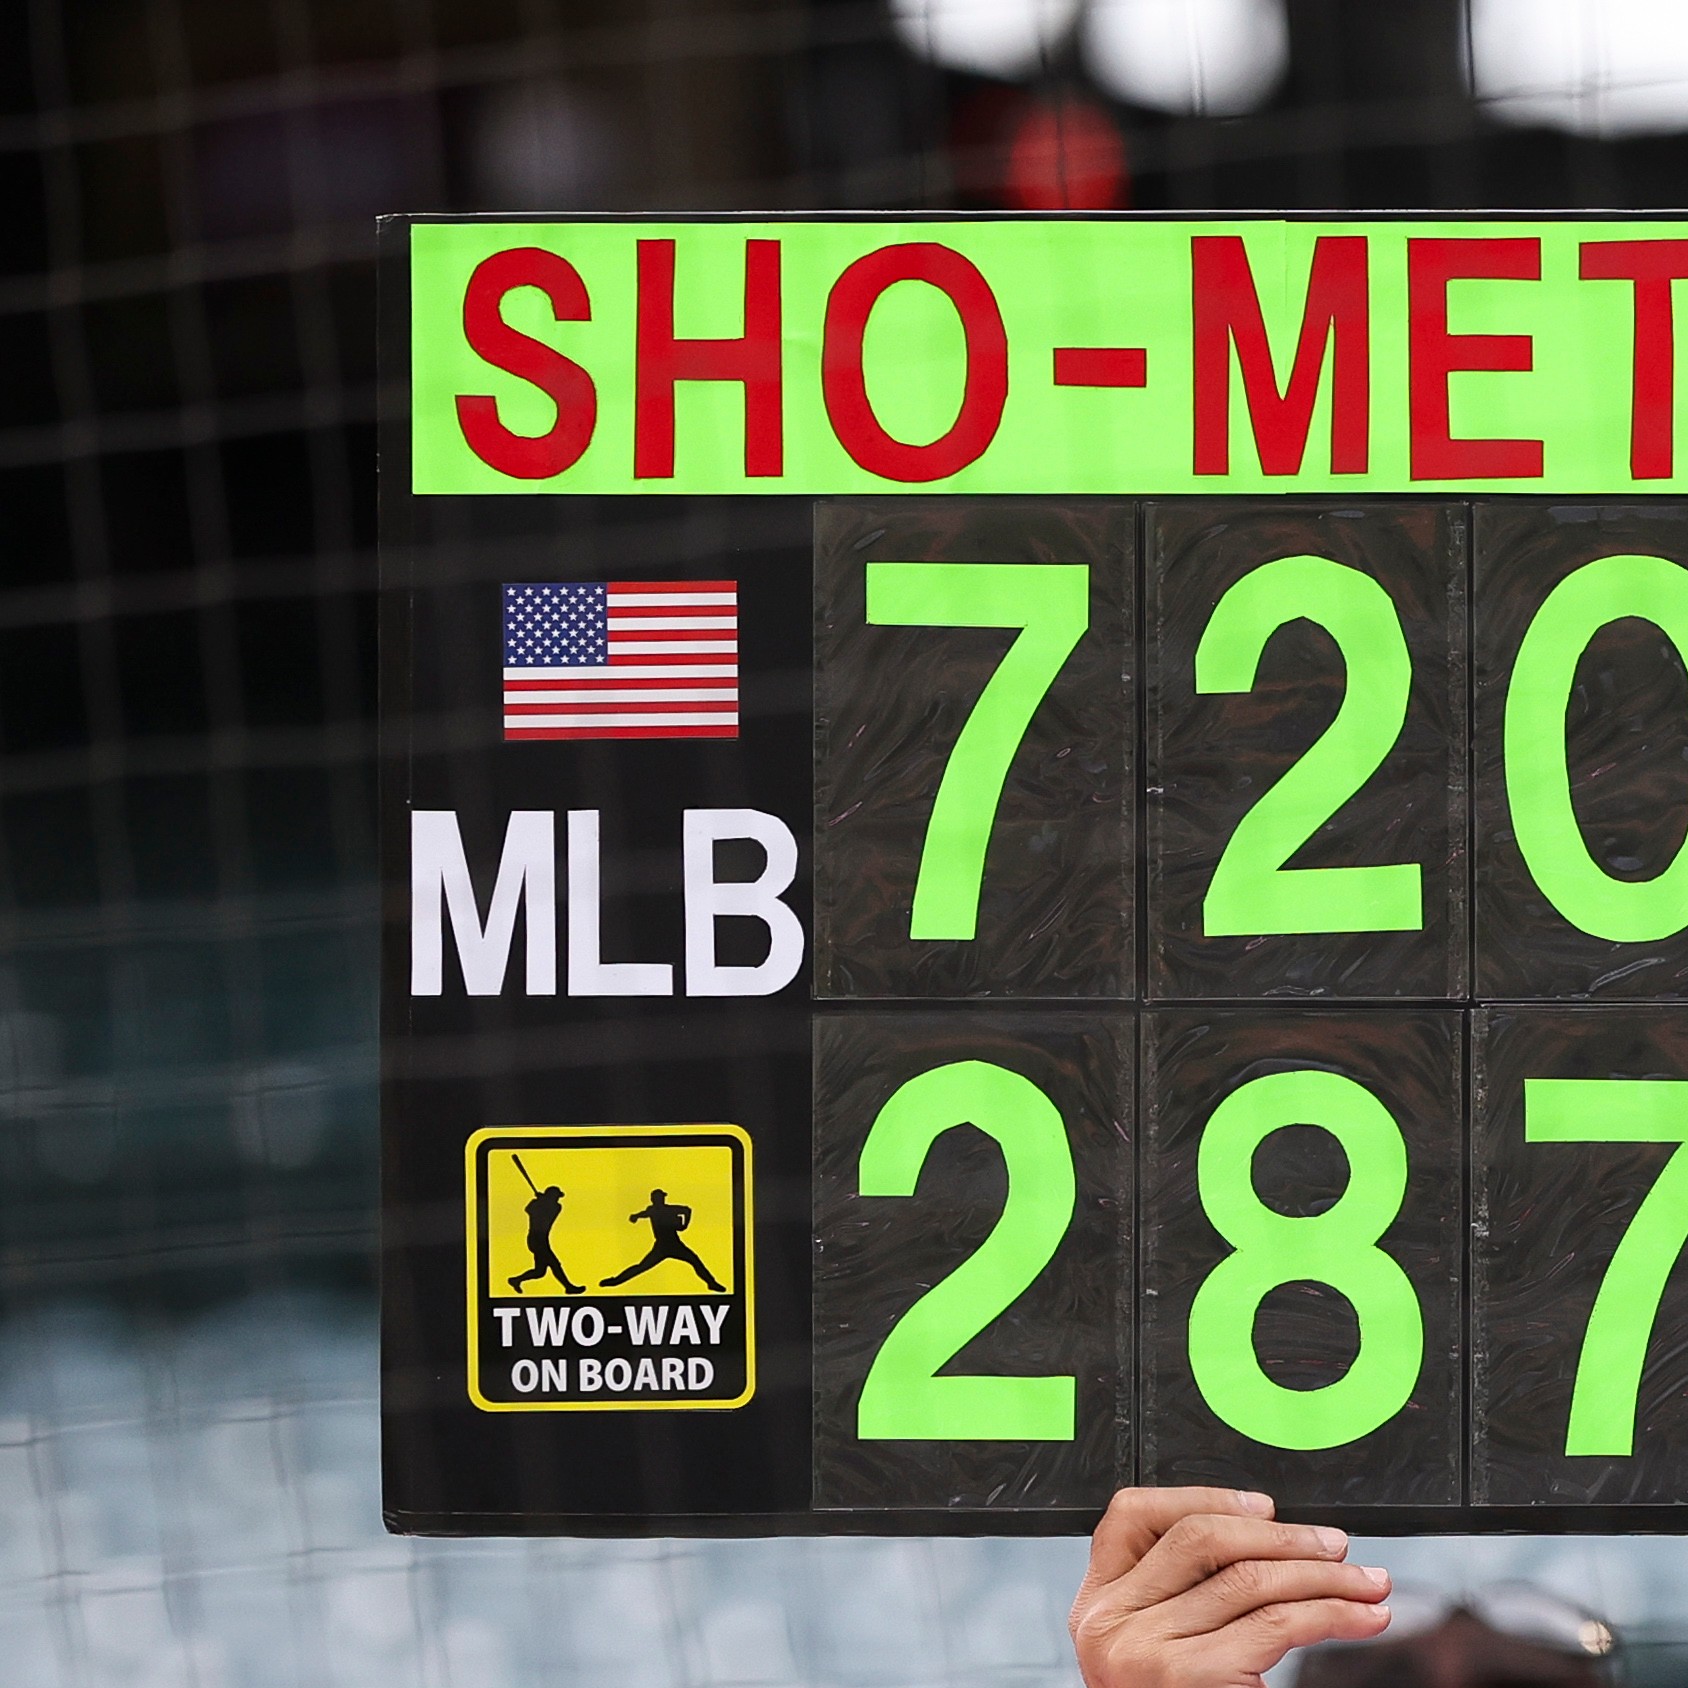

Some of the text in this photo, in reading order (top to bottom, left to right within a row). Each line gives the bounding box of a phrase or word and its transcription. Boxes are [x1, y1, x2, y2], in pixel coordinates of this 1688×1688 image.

[409, 807, 806, 998] MLB
[492, 1304, 731, 1348] TWO-WAY
[510, 1356, 715, 1393] ON BOARD
